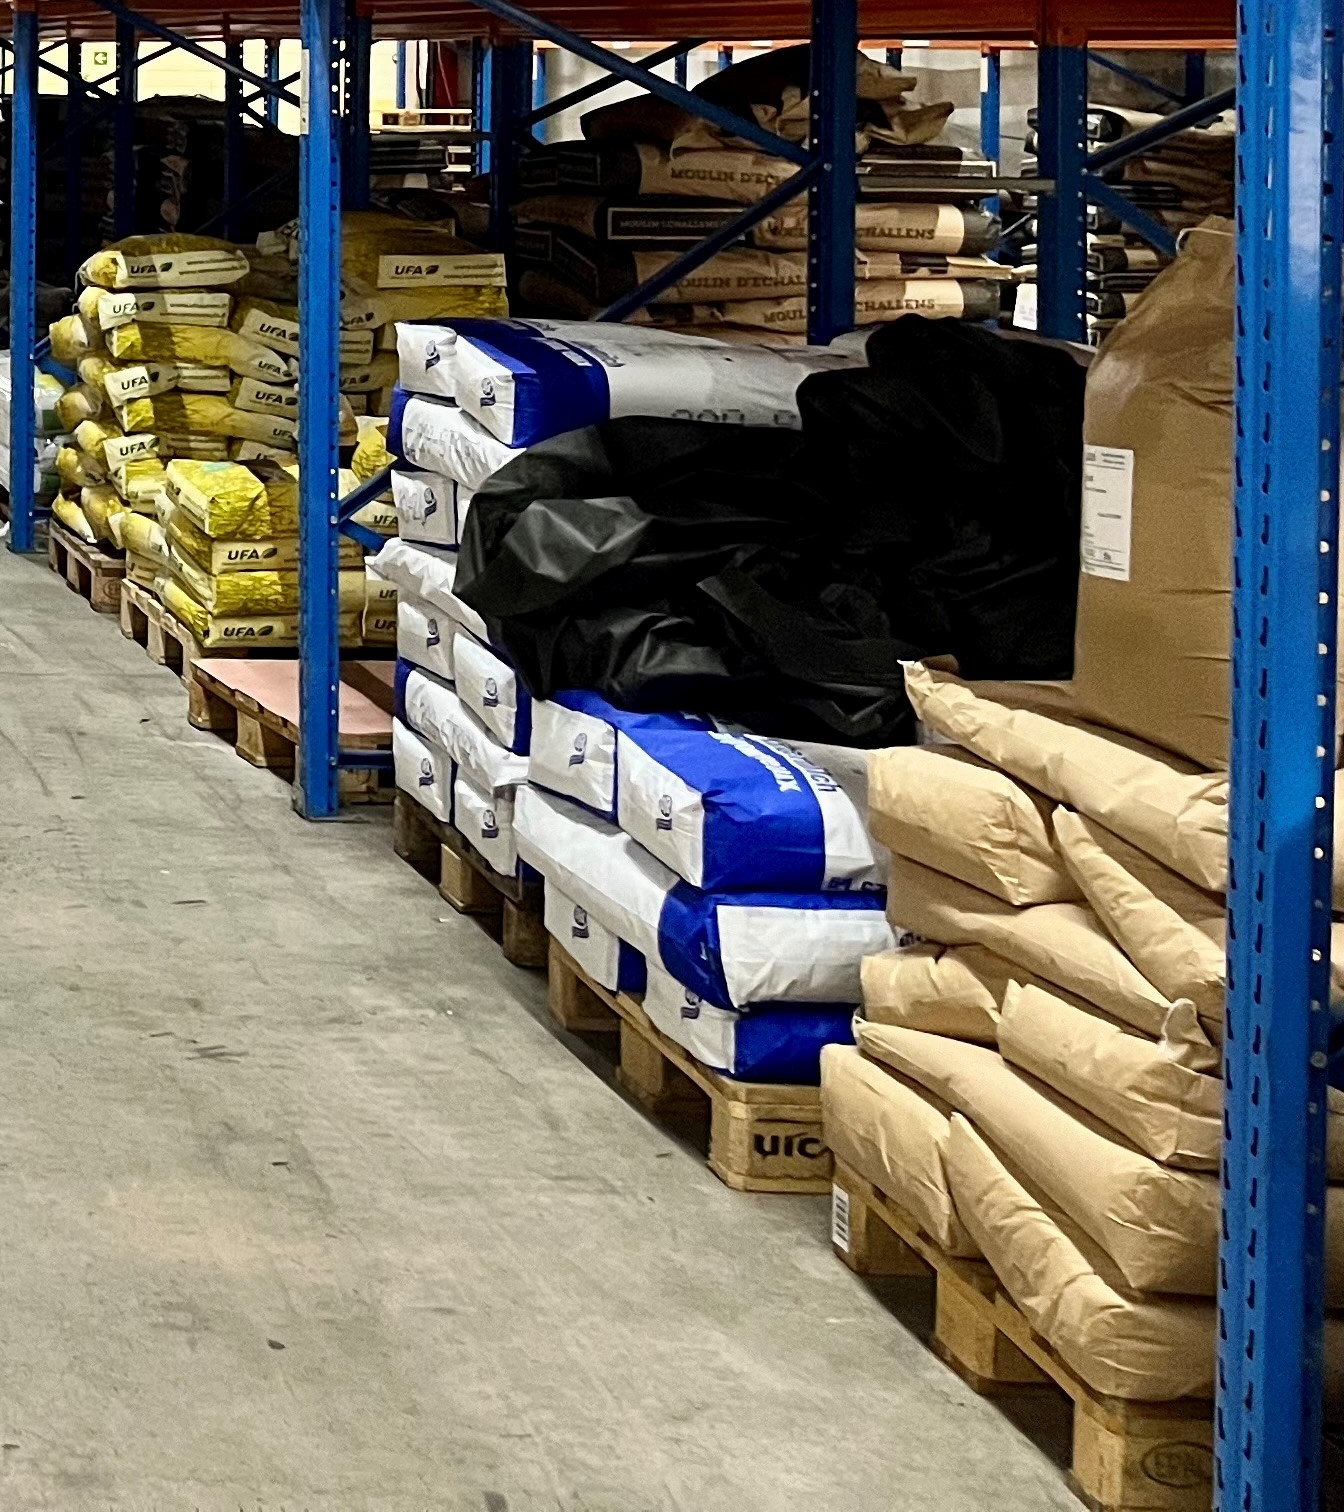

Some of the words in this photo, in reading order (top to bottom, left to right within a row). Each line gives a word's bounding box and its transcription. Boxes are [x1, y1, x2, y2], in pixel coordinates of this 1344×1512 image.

[130, 263, 157, 274] UFA
[395, 264, 423, 276] UFA
[113, 301, 140, 314] UFA
[259, 323, 287, 339] UFA
[258, 360, 281, 375] UFA
[121, 375, 148, 391] UFA
[255, 390, 283, 404] UFA
[120, 441, 146, 457] UFA
[227, 548, 260, 561] UFA
[223, 626, 255, 637] UFA
